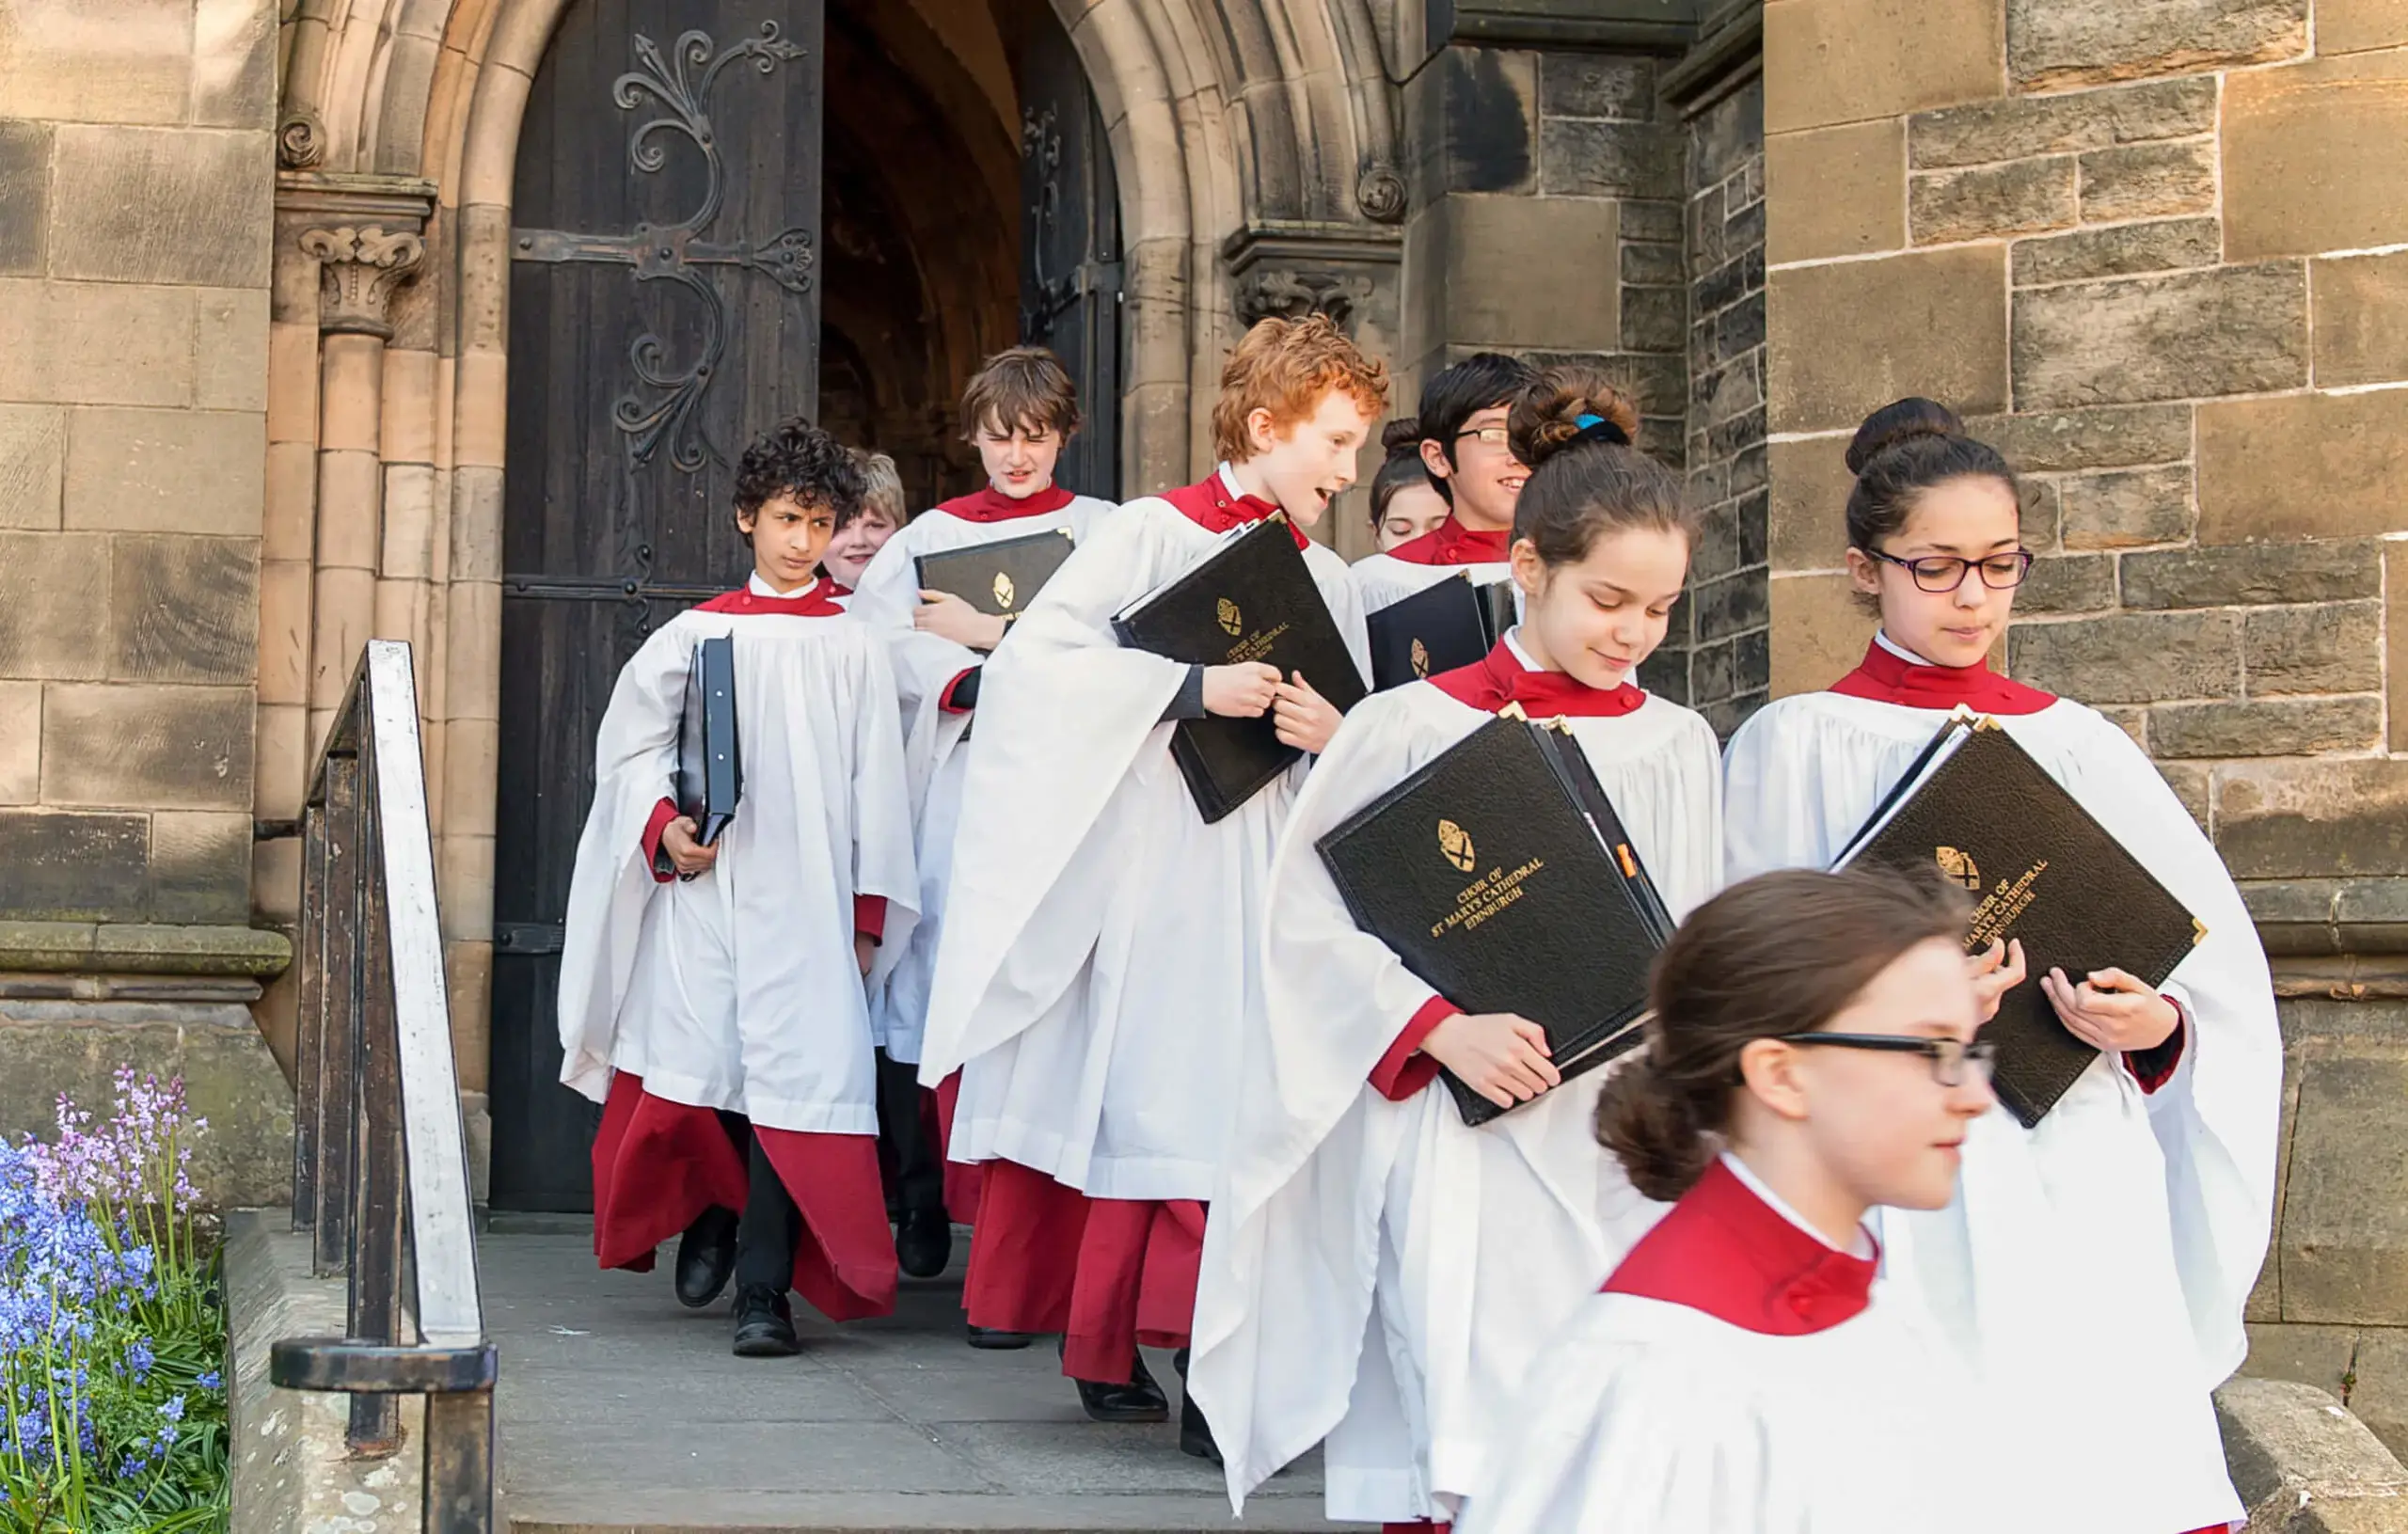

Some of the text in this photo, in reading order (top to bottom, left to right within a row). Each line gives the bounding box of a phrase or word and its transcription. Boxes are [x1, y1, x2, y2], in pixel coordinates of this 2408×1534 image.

[1244, 621, 1290, 656] CATHEDRAL
[1249, 629, 1259, 642] OF
[1431, 922, 1445, 938] ST
[1482, 858, 1544, 902] CATHEDRAL
[1457, 866, 1502, 904] CHOIR OF
[1968, 878, 2009, 924] CHOIR OF
[1994, 859, 2048, 915] CATHEDRAL
[1464, 886, 1524, 930] EDINBURGH
[1981, 889, 2036, 946] EDINBURGH
